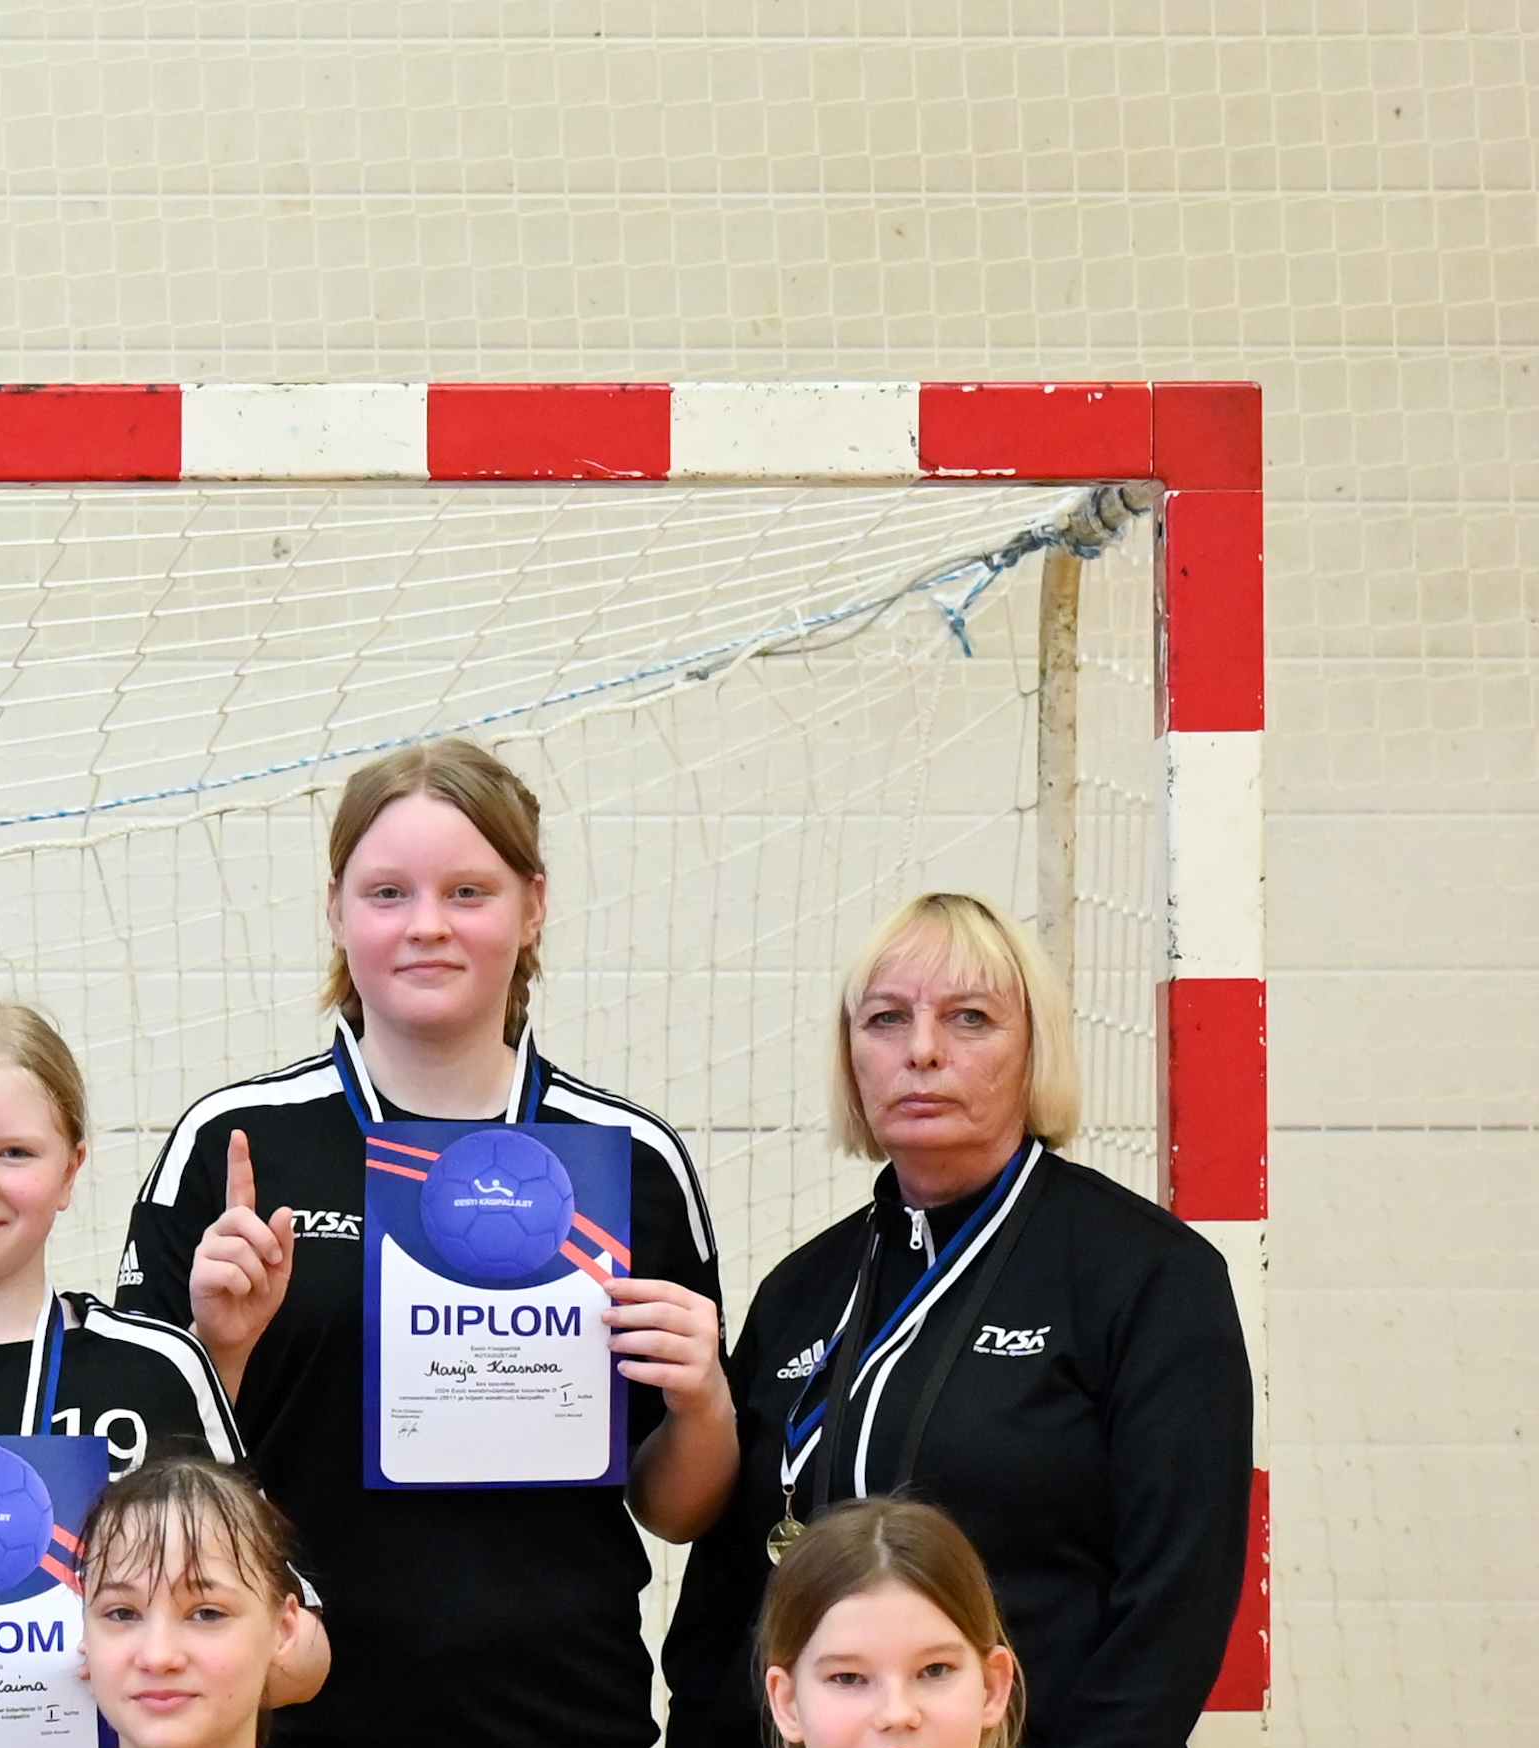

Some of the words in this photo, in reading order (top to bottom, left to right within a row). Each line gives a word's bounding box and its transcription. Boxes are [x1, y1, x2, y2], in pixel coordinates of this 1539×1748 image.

[411, 1305, 581, 1336] DIPLOM
[975, 1325, 1051, 1350] TVSK
[424, 1360, 477, 1383] Marija
